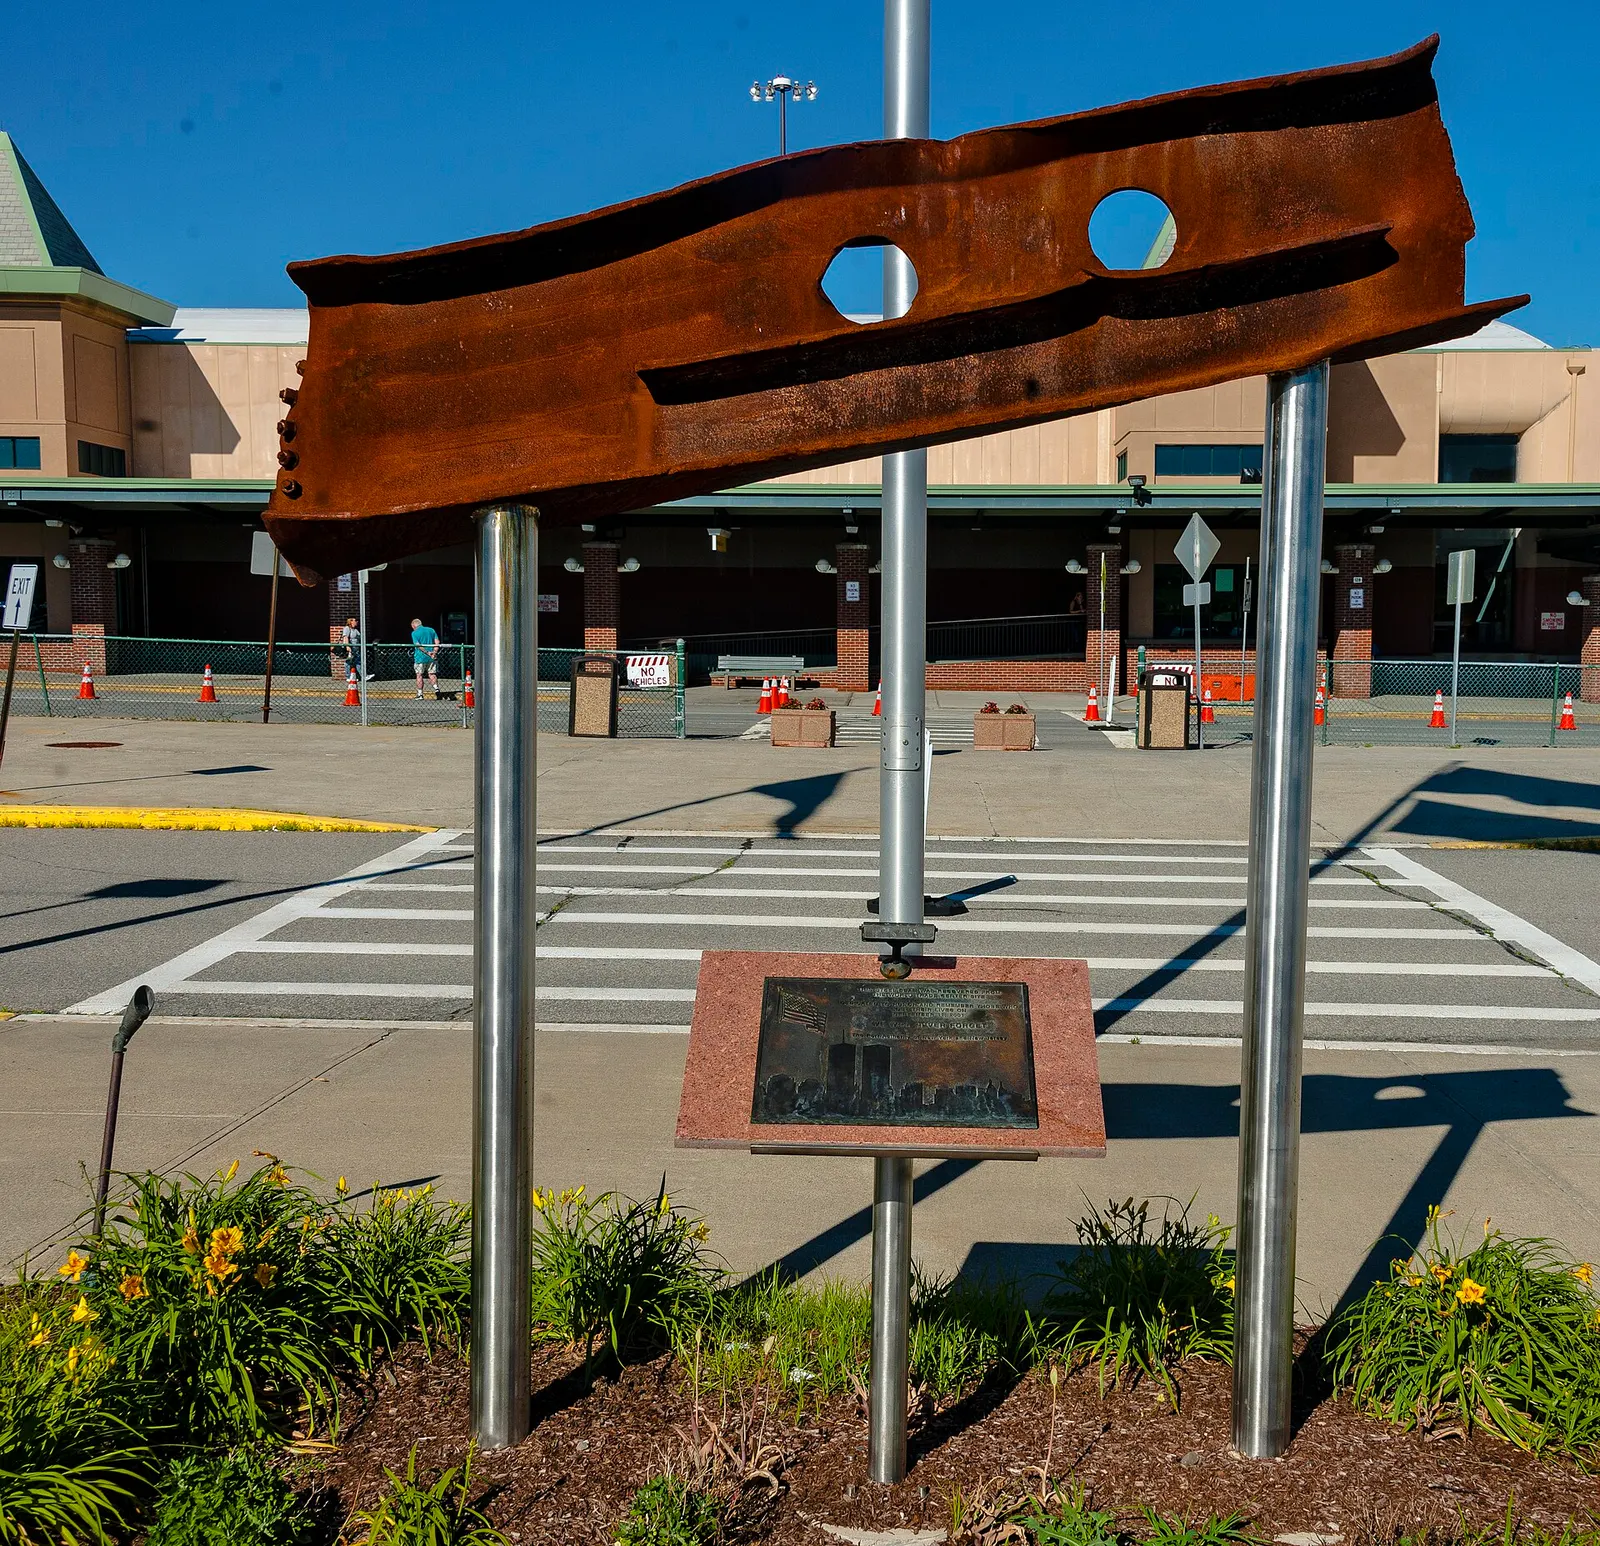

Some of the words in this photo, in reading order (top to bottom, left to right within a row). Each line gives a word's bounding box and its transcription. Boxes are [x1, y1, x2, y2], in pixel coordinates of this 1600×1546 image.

[12, 577, 31, 595] EXIT
[641, 667, 655, 677] NO
[632, 677, 667, 685] VEHICLES
